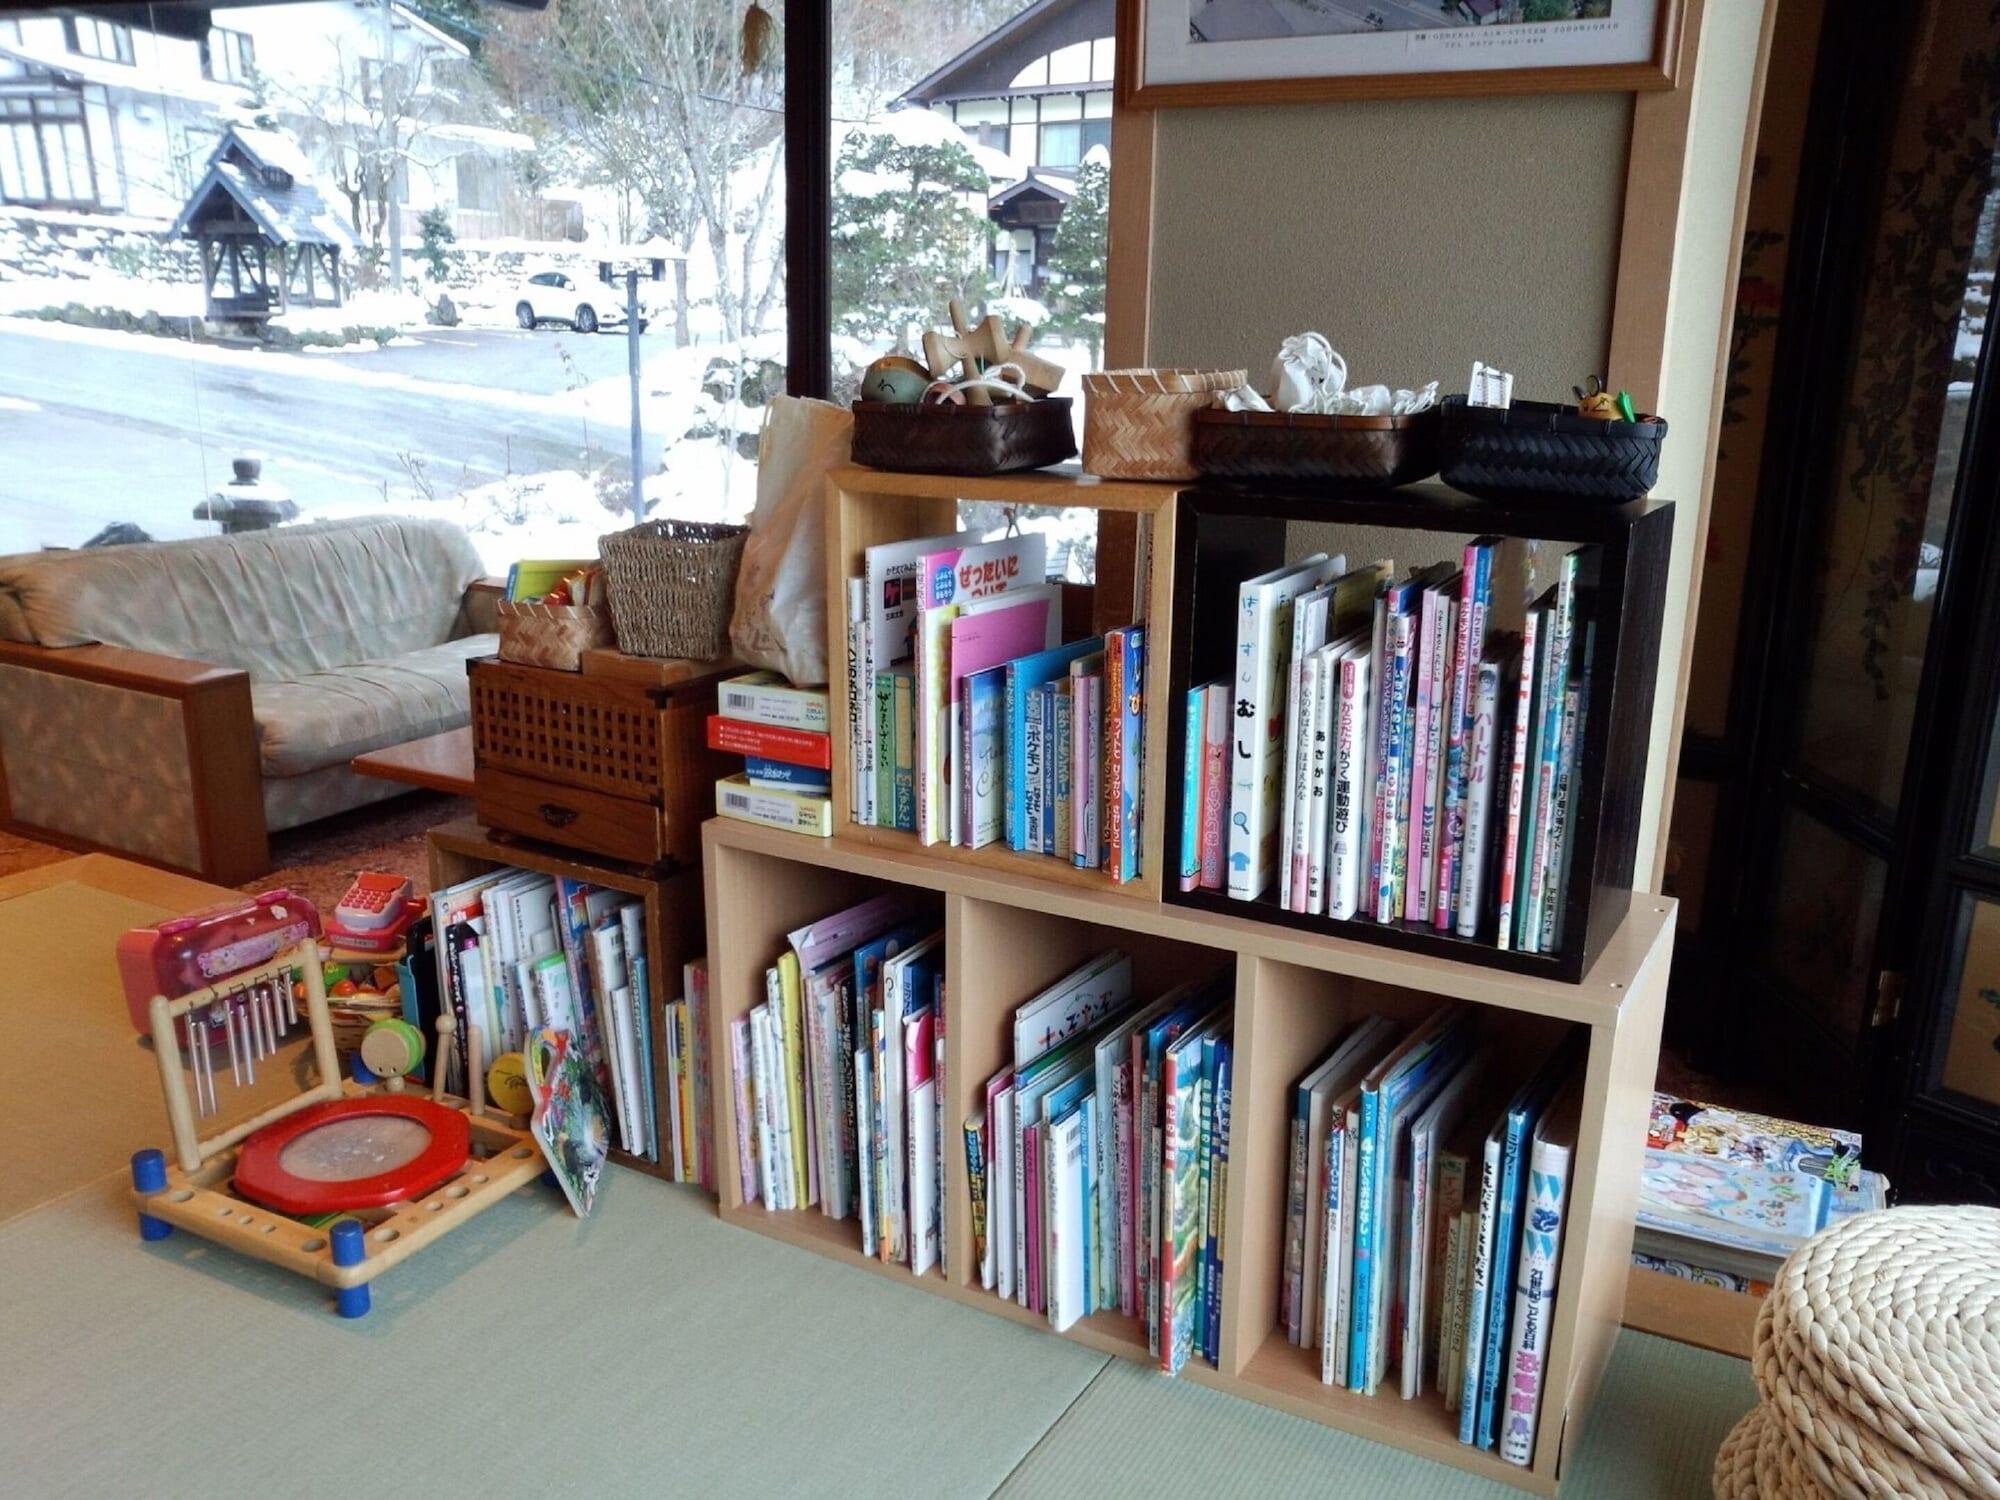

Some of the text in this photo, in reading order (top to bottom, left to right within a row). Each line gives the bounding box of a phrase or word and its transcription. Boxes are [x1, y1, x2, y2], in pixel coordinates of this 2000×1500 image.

[960, 555, 1018, 588] ぜったいに
[1236, 698, 1256, 759] むし
[1469, 712, 1492, 783] ハードル
[1313, 730, 1326, 798] あさがお
[1336, 702, 1354, 834] からだ力がつく運動遊び
[1522, 1268, 1544, 1351] 21世紀こども百科
